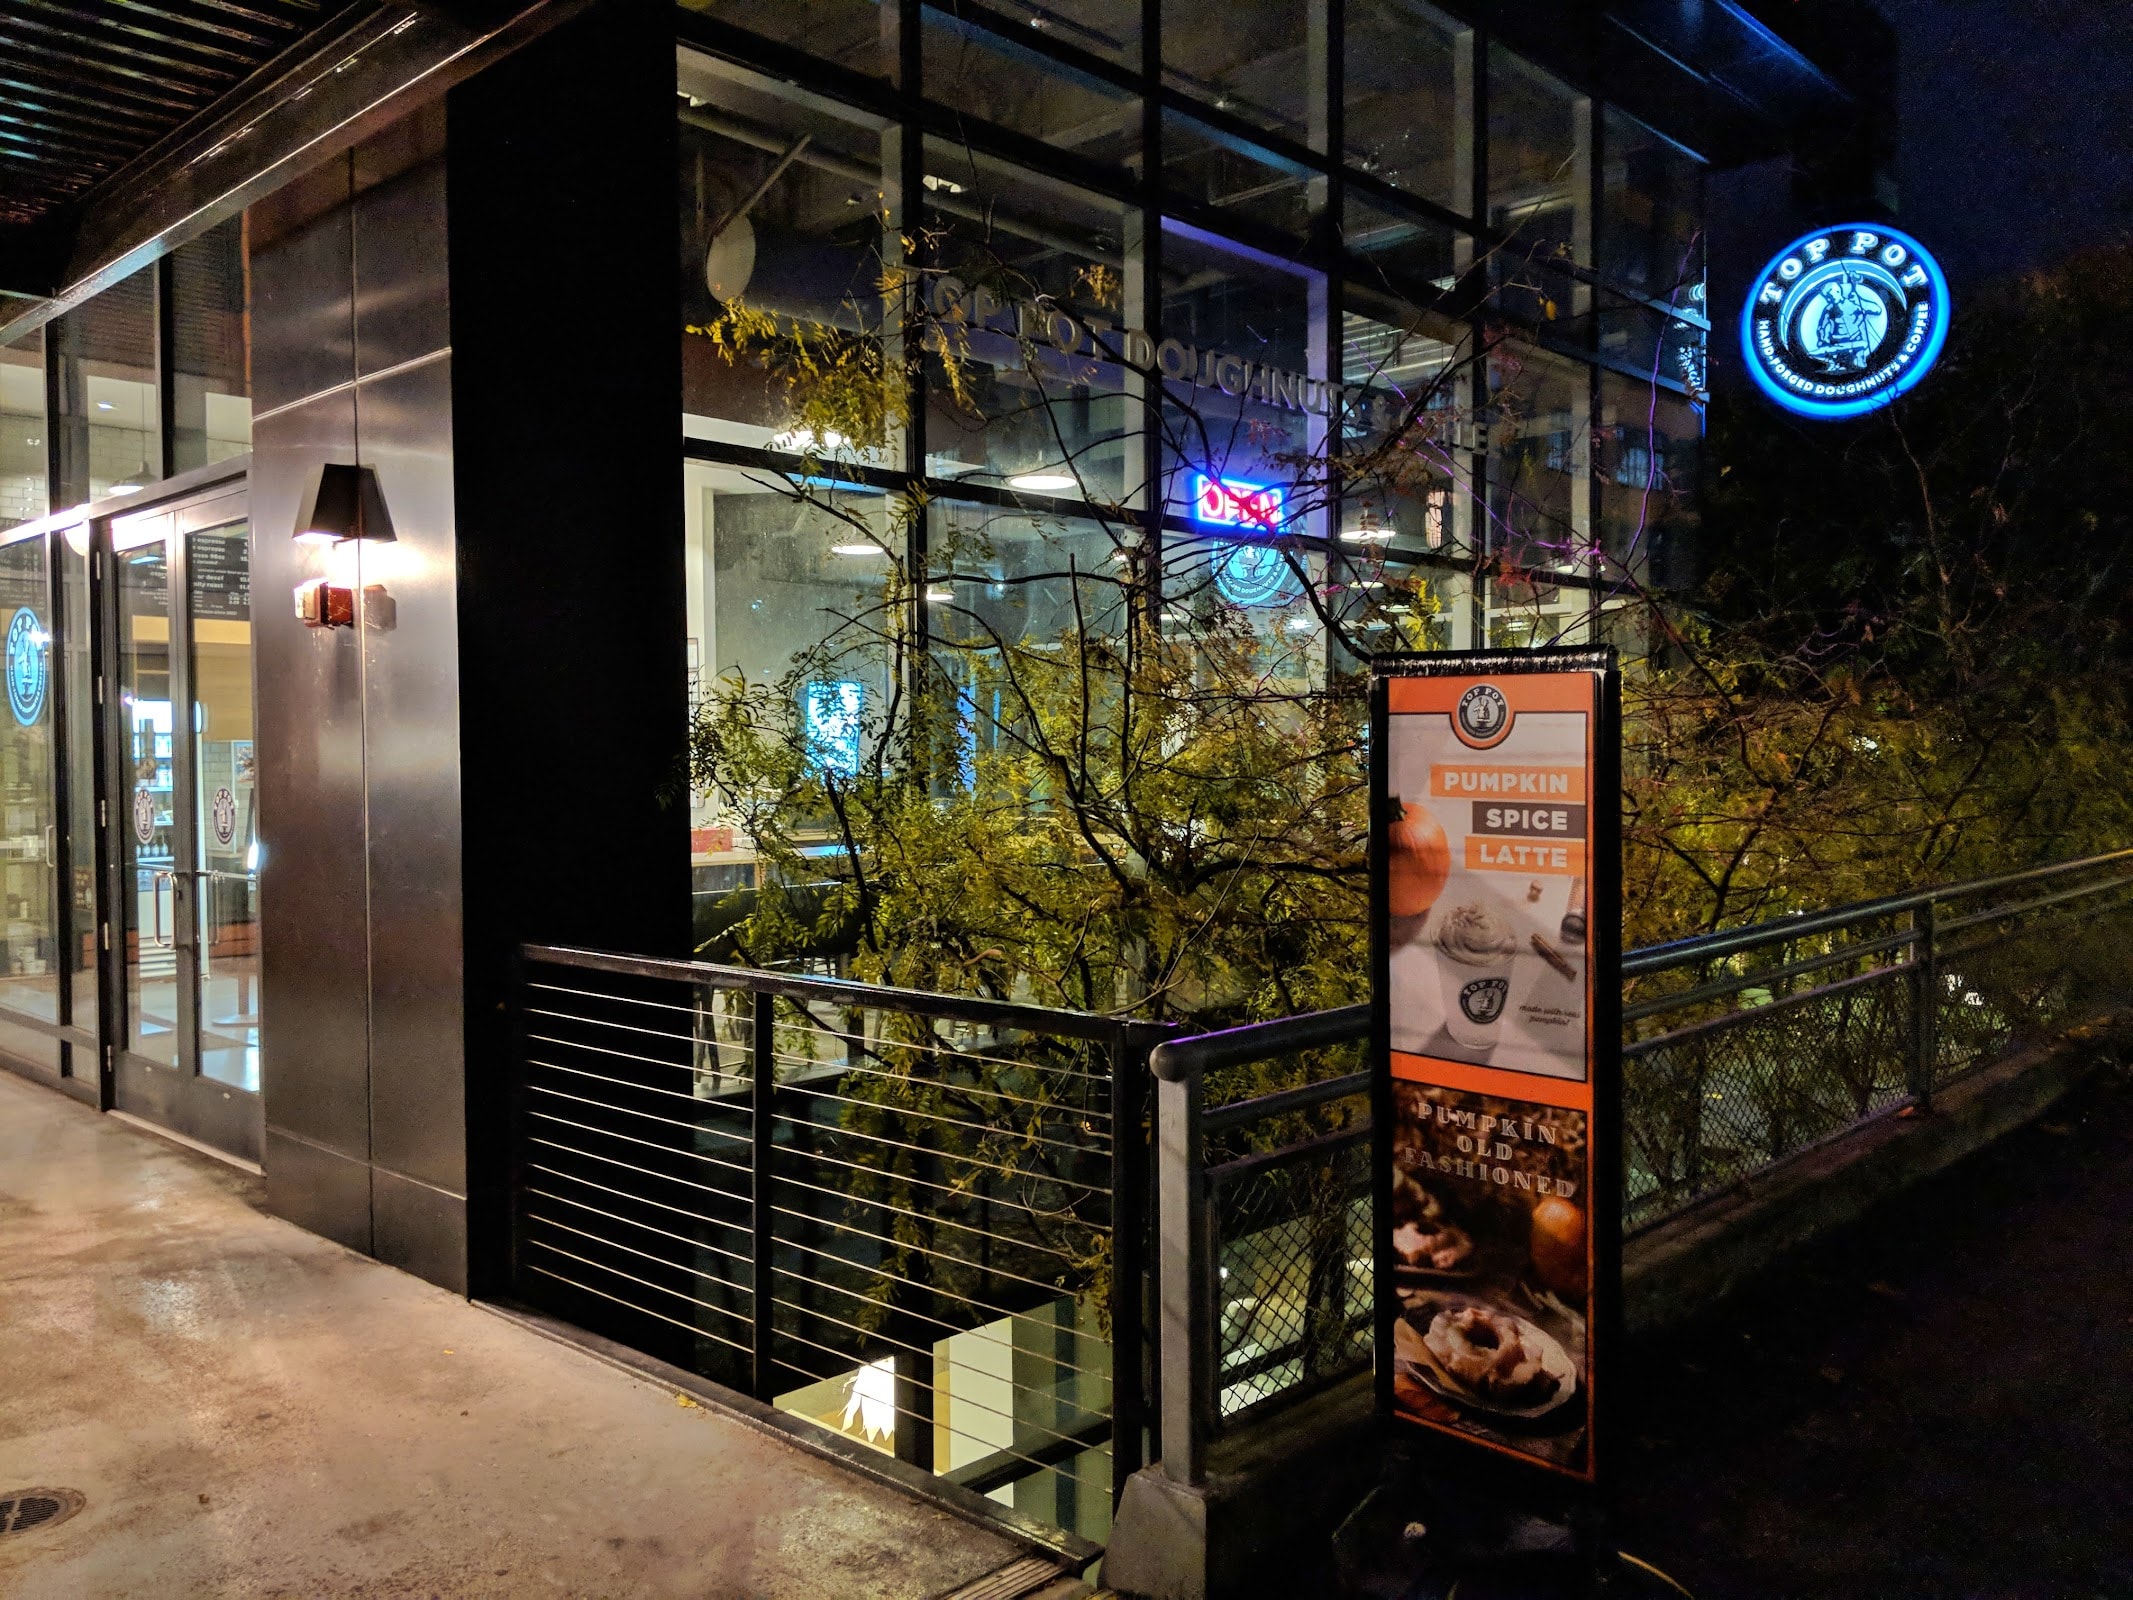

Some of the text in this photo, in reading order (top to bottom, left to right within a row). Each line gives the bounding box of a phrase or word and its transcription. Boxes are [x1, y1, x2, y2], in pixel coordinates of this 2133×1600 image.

[1759, 231, 1929, 305] TOP POT
[1905, 301, 1930, 354] COFFEE
[1127, 328, 1362, 426] DOUGHNUTS
[1461, 687, 1505, 707] TOP POT
[1444, 771, 1569, 794] PUMPKIN
[1486, 808, 1569, 831] SPICE
[1479, 843, 1568, 868] LATTE
[1417, 1102, 1557, 1145] PUMPKIN
[1456, 1135, 1513, 1162] OLD
[1404, 1147, 1576, 1199] FASHIONED
